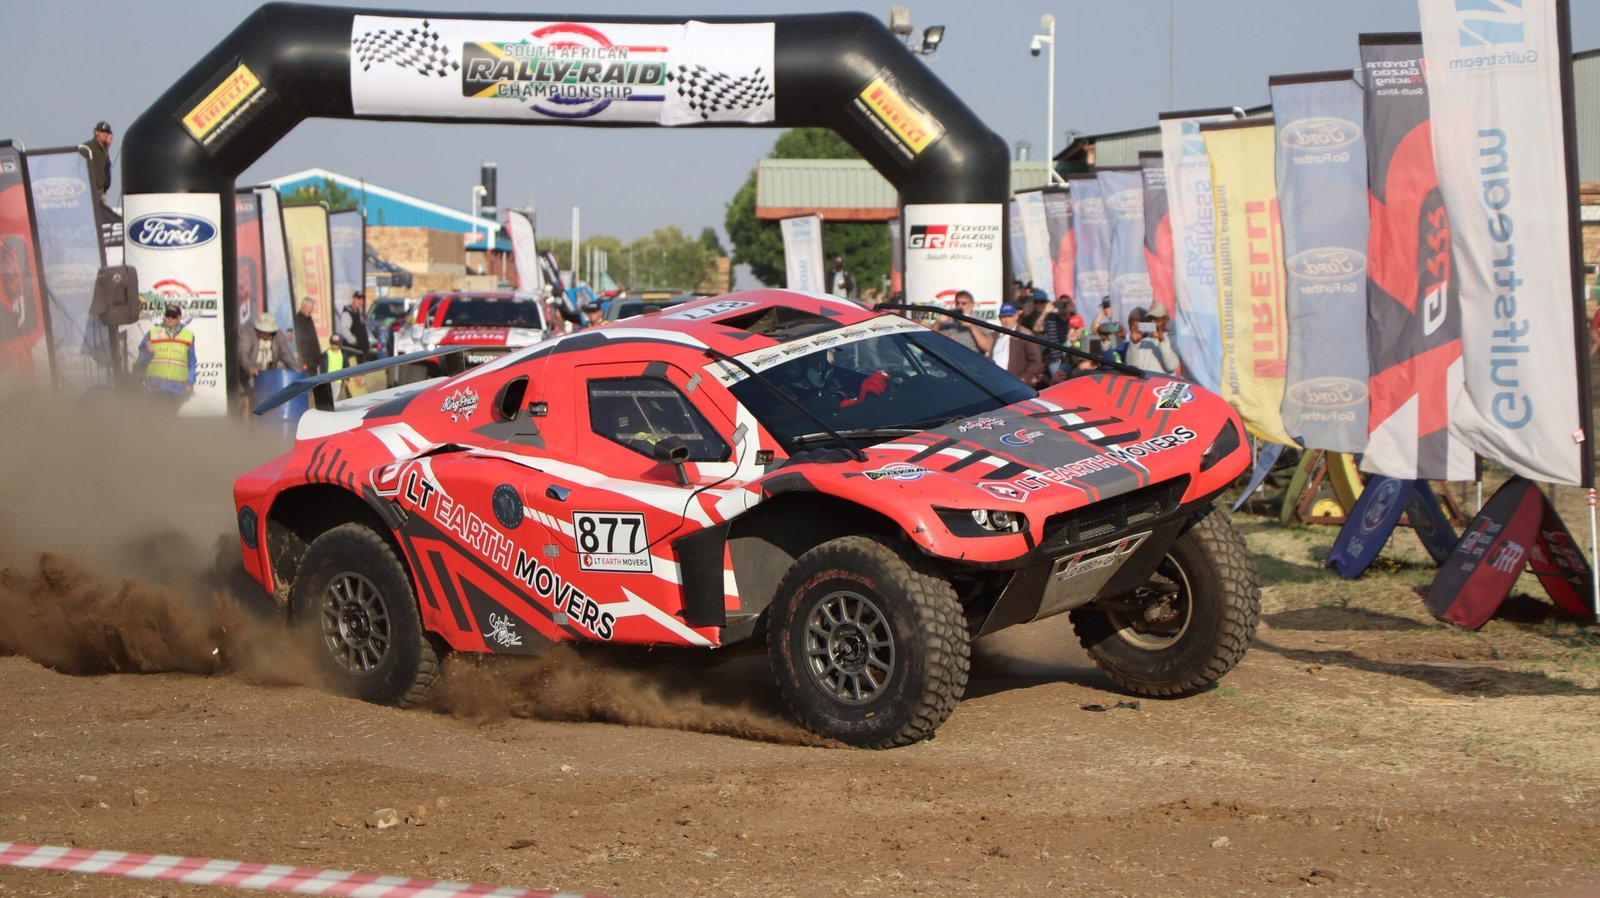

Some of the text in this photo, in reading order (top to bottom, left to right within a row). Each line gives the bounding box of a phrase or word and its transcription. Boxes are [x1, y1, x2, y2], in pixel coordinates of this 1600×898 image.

[503, 43, 628, 60] SOUTH AFRICAN
[467, 58, 666, 87] RALLY-RAID
[497, 83, 633, 101] CHAMPIONSHIP
[192, 74, 249, 129] PIRELLI
[870, 87, 926, 143] PIRELLI
[138, 215, 200, 245] Ford
[950, 232, 995, 240] GAZOO
[952, 224, 1000, 232] TOYOTA
[909, 233, 947, 249] GR
[949, 241, 993, 250] Racing
[926, 252, 973, 261] South Africa
[198, 379, 217, 387] ing
[1015, 425, 1198, 491] LT EARTH MOVERS
[579, 516, 641, 553] 877
[405, 472, 434, 510] LT
[434, 494, 515, 571] EARTH
[514, 549, 616, 641] MOVERS
[602, 558, 622, 566] EARTH
[623, 559, 648, 567] MOVERS
